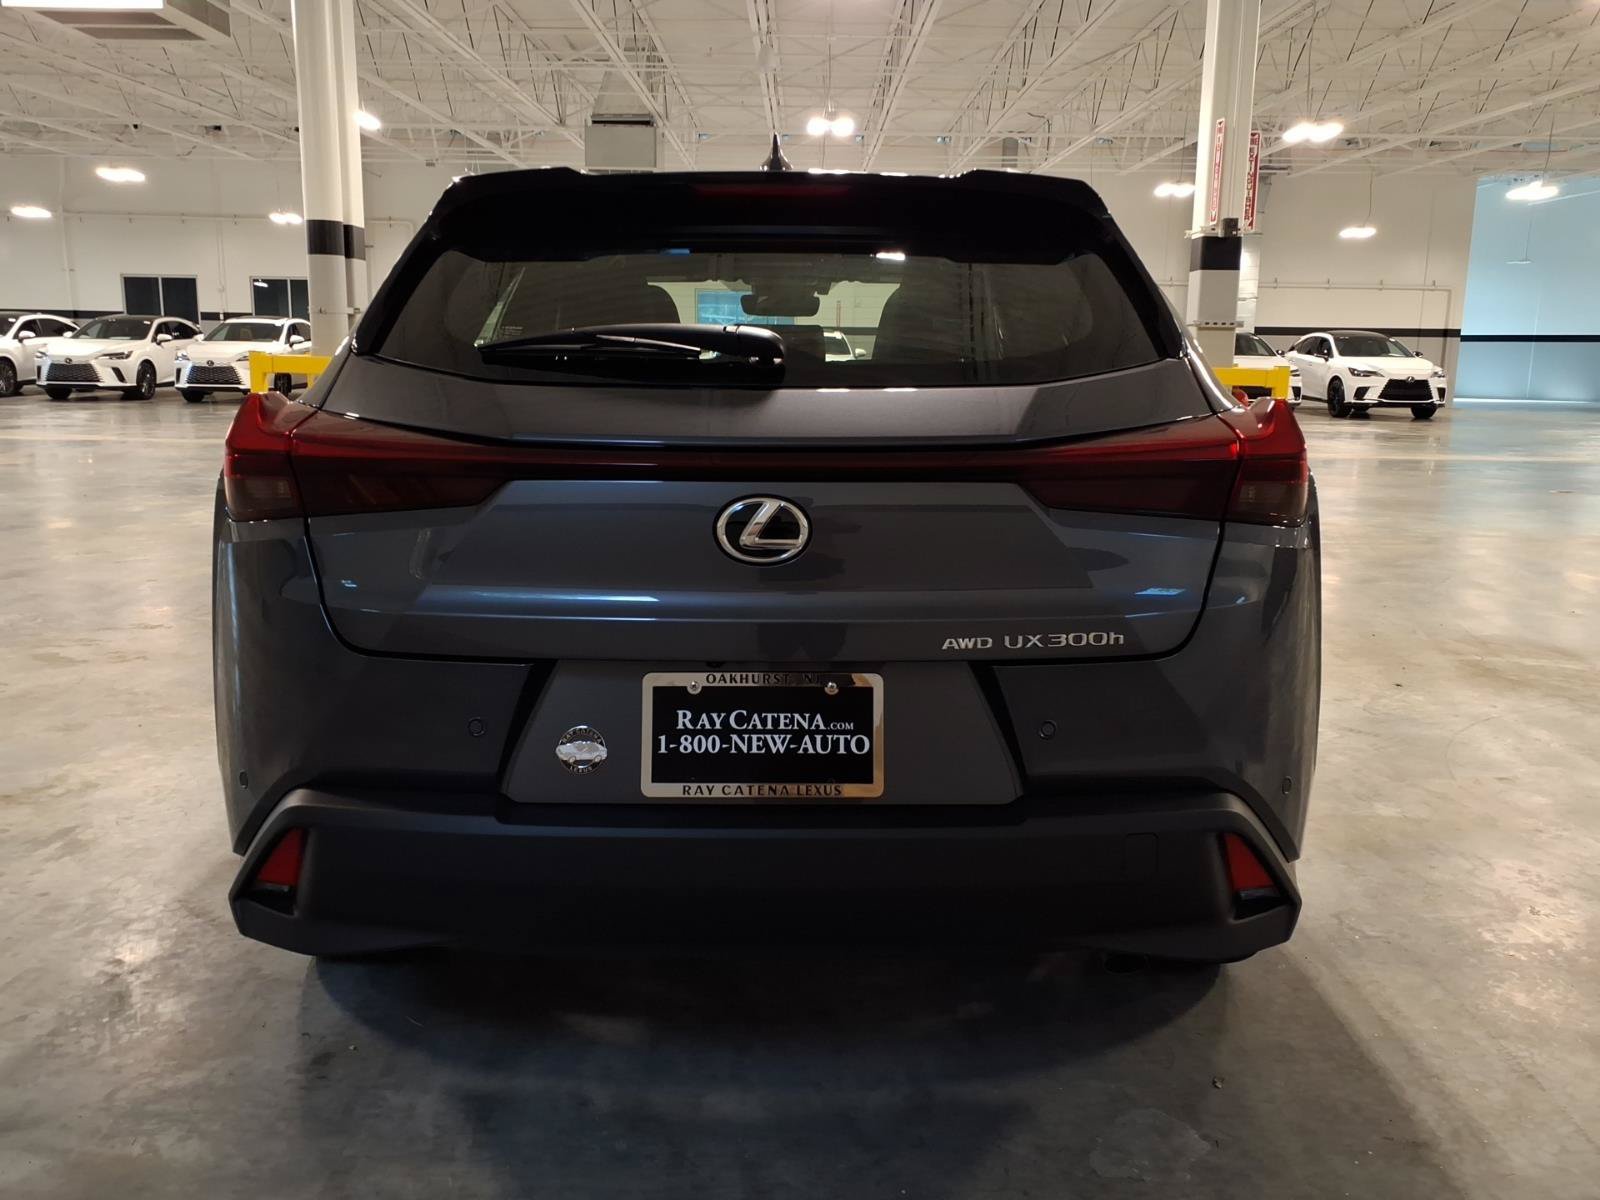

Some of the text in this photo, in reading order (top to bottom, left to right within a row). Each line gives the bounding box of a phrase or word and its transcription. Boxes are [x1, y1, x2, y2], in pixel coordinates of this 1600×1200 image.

[941, 637, 993, 650] AWD
[657, 733, 871, 755] 1-800-NEW-AUTO
[682, 785, 842, 796] RAY CATENA LEXUS
